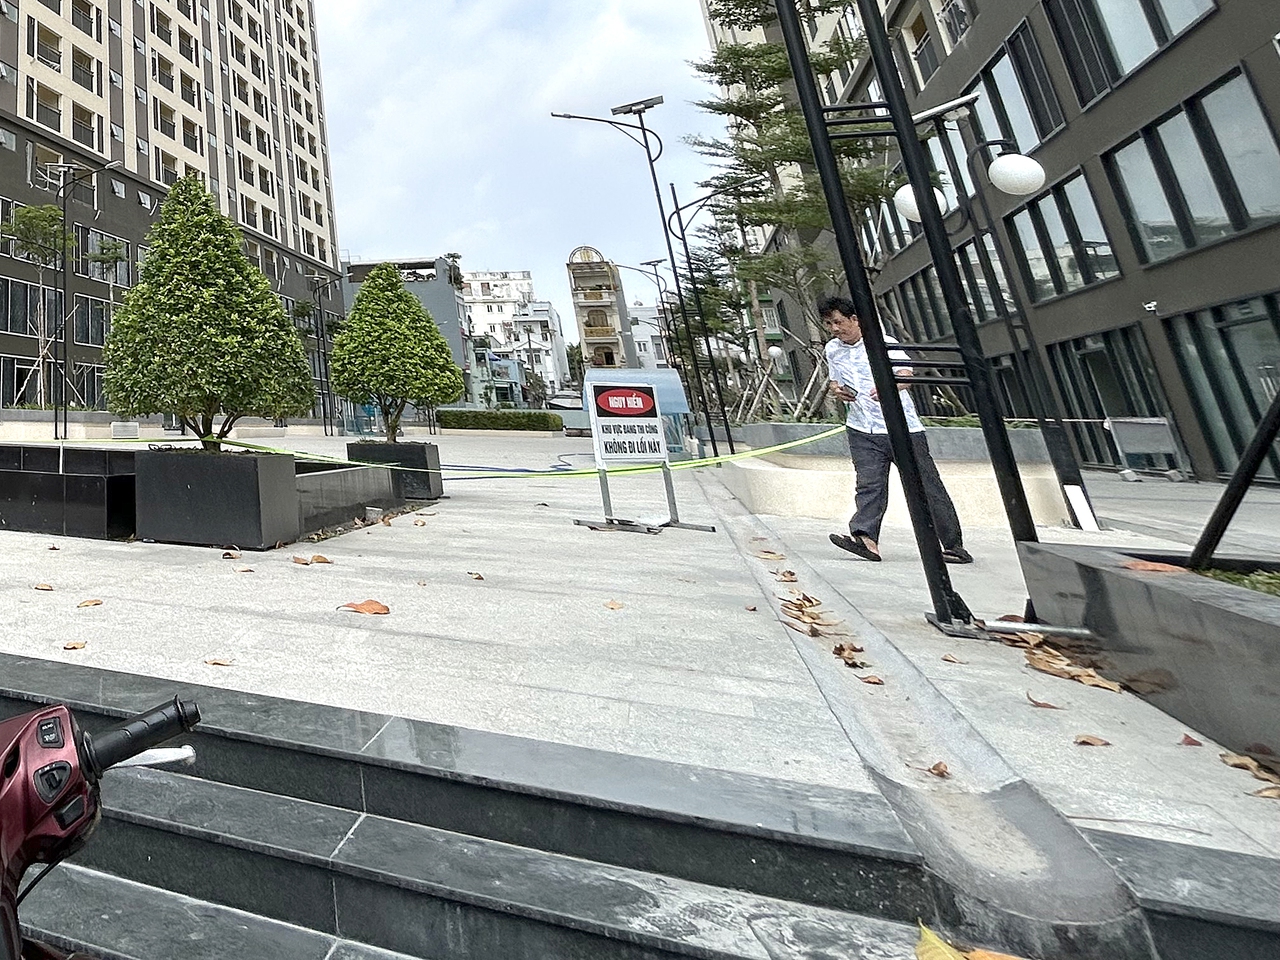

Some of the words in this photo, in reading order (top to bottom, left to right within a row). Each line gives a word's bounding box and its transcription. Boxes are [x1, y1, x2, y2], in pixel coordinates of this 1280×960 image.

[608, 396, 625, 408] NGUY
[626, 393, 643, 408] HIỂM
[602, 425, 612, 434] KHU
[645, 423, 658, 434] CÔNG
[604, 438, 627, 453] KHÔNG
[628, 441, 636, 453] ĐI
[636, 436, 647, 453] LỐI
[648, 438, 661, 453] NÀY
